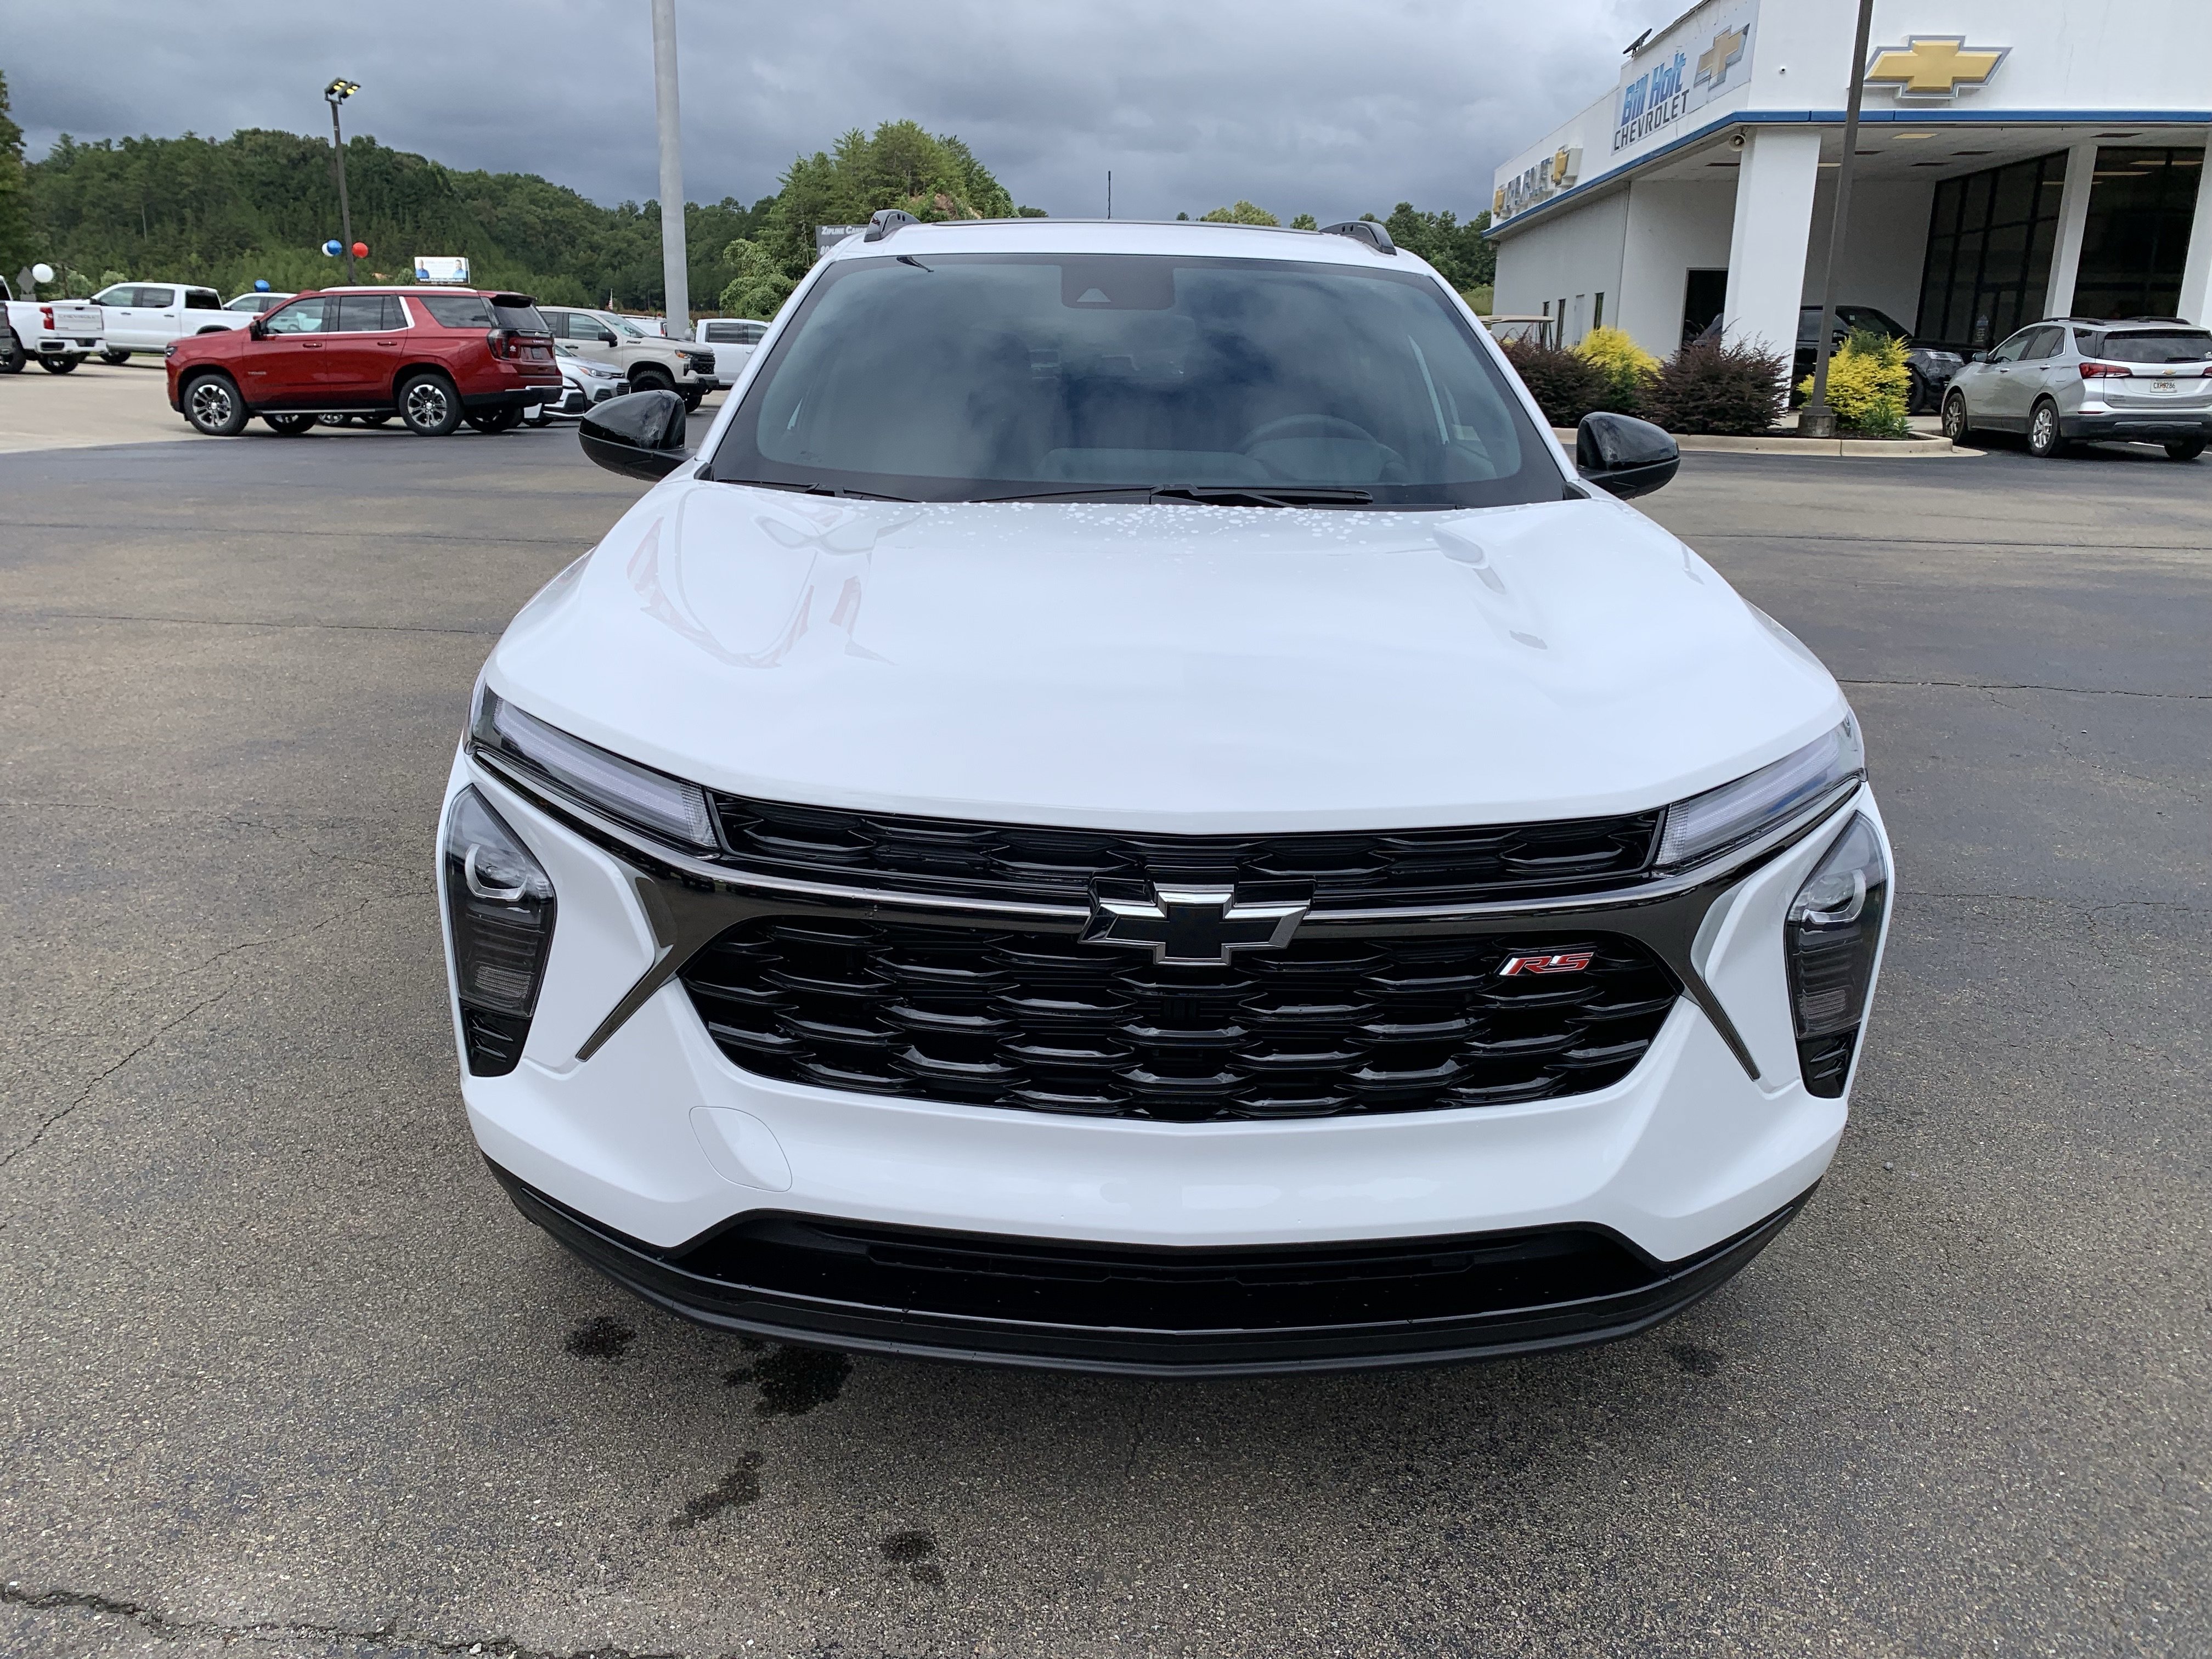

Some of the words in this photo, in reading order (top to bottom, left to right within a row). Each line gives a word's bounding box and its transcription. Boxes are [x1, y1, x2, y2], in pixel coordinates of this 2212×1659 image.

[1614, 89, 1690, 151] CHEVROLET
[1621, 73, 1649, 127] Bill
[1648, 52, 1686, 110] Holt
[1499, 952, 1594, 975] RS
